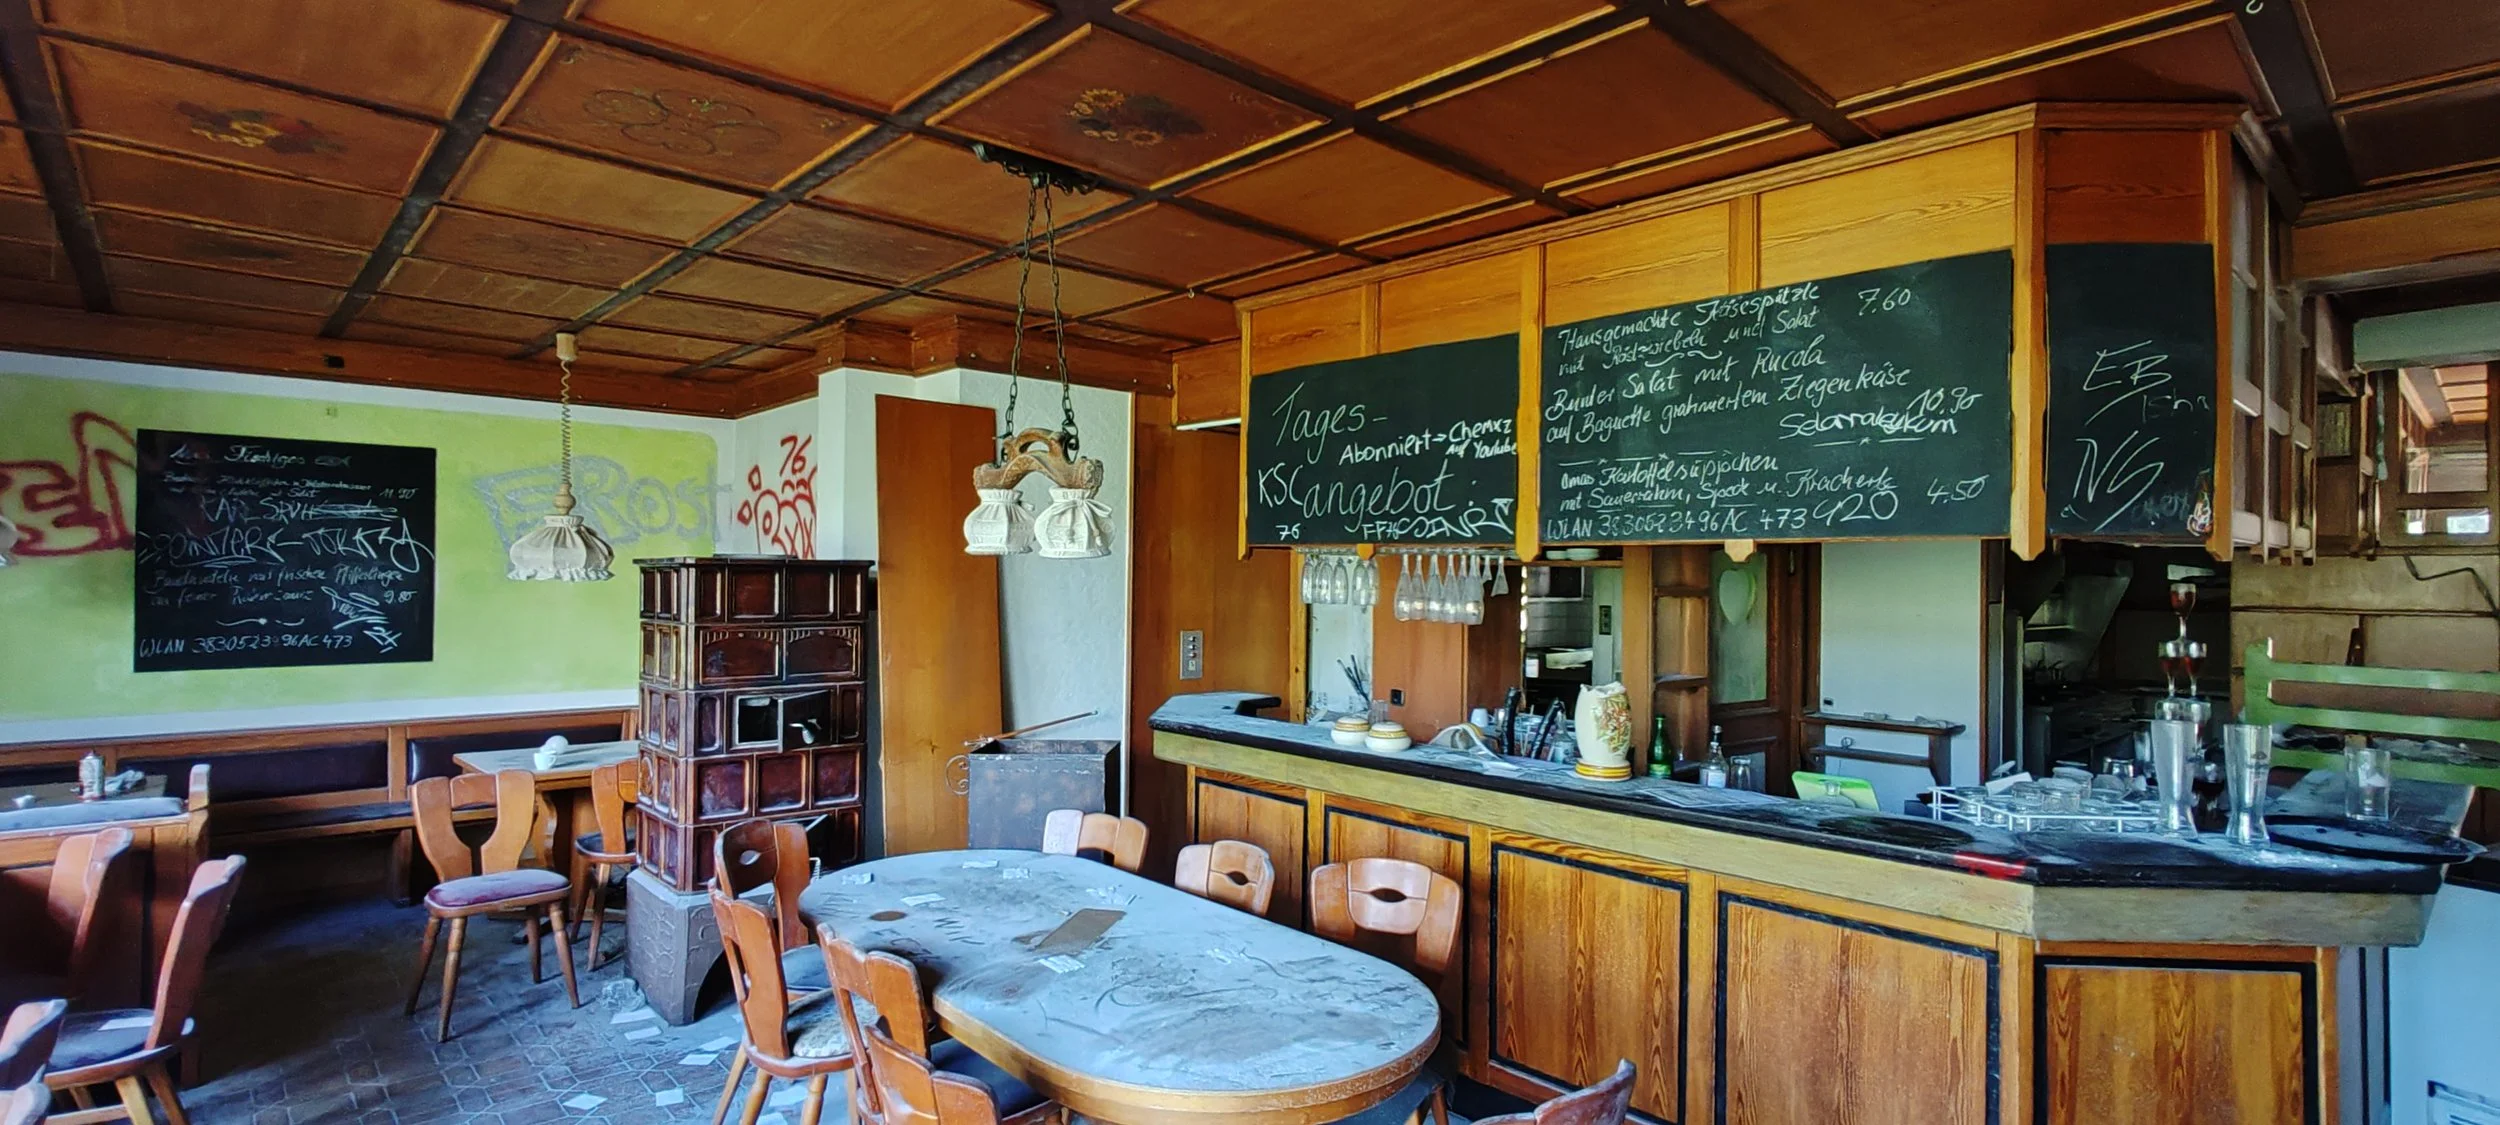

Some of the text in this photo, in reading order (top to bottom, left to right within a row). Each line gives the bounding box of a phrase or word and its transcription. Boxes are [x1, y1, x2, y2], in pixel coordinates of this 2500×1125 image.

[1858, 287, 1911, 316] 7.60
[1723, 315, 1766, 343] und
[1772, 305, 1820, 334] Salat
[1622, 367, 1682, 398] Salat
[1694, 356, 1740, 385] mit
[1751, 334, 1828, 379] Rucola
[1546, 414, 1574, 444] auf
[1576, 402, 1651, 443] Baguette
[780, 434, 812, 476] 76
[1339, 428, 1433, 466] Abonniert
[1696, 478, 1750, 509] Speck
[1926, 474, 1991, 505] 4.50
[1276, 523, 1302, 541] 76
[1547, 518, 1593, 540] WLAN
[1759, 507, 1808, 530] 473
